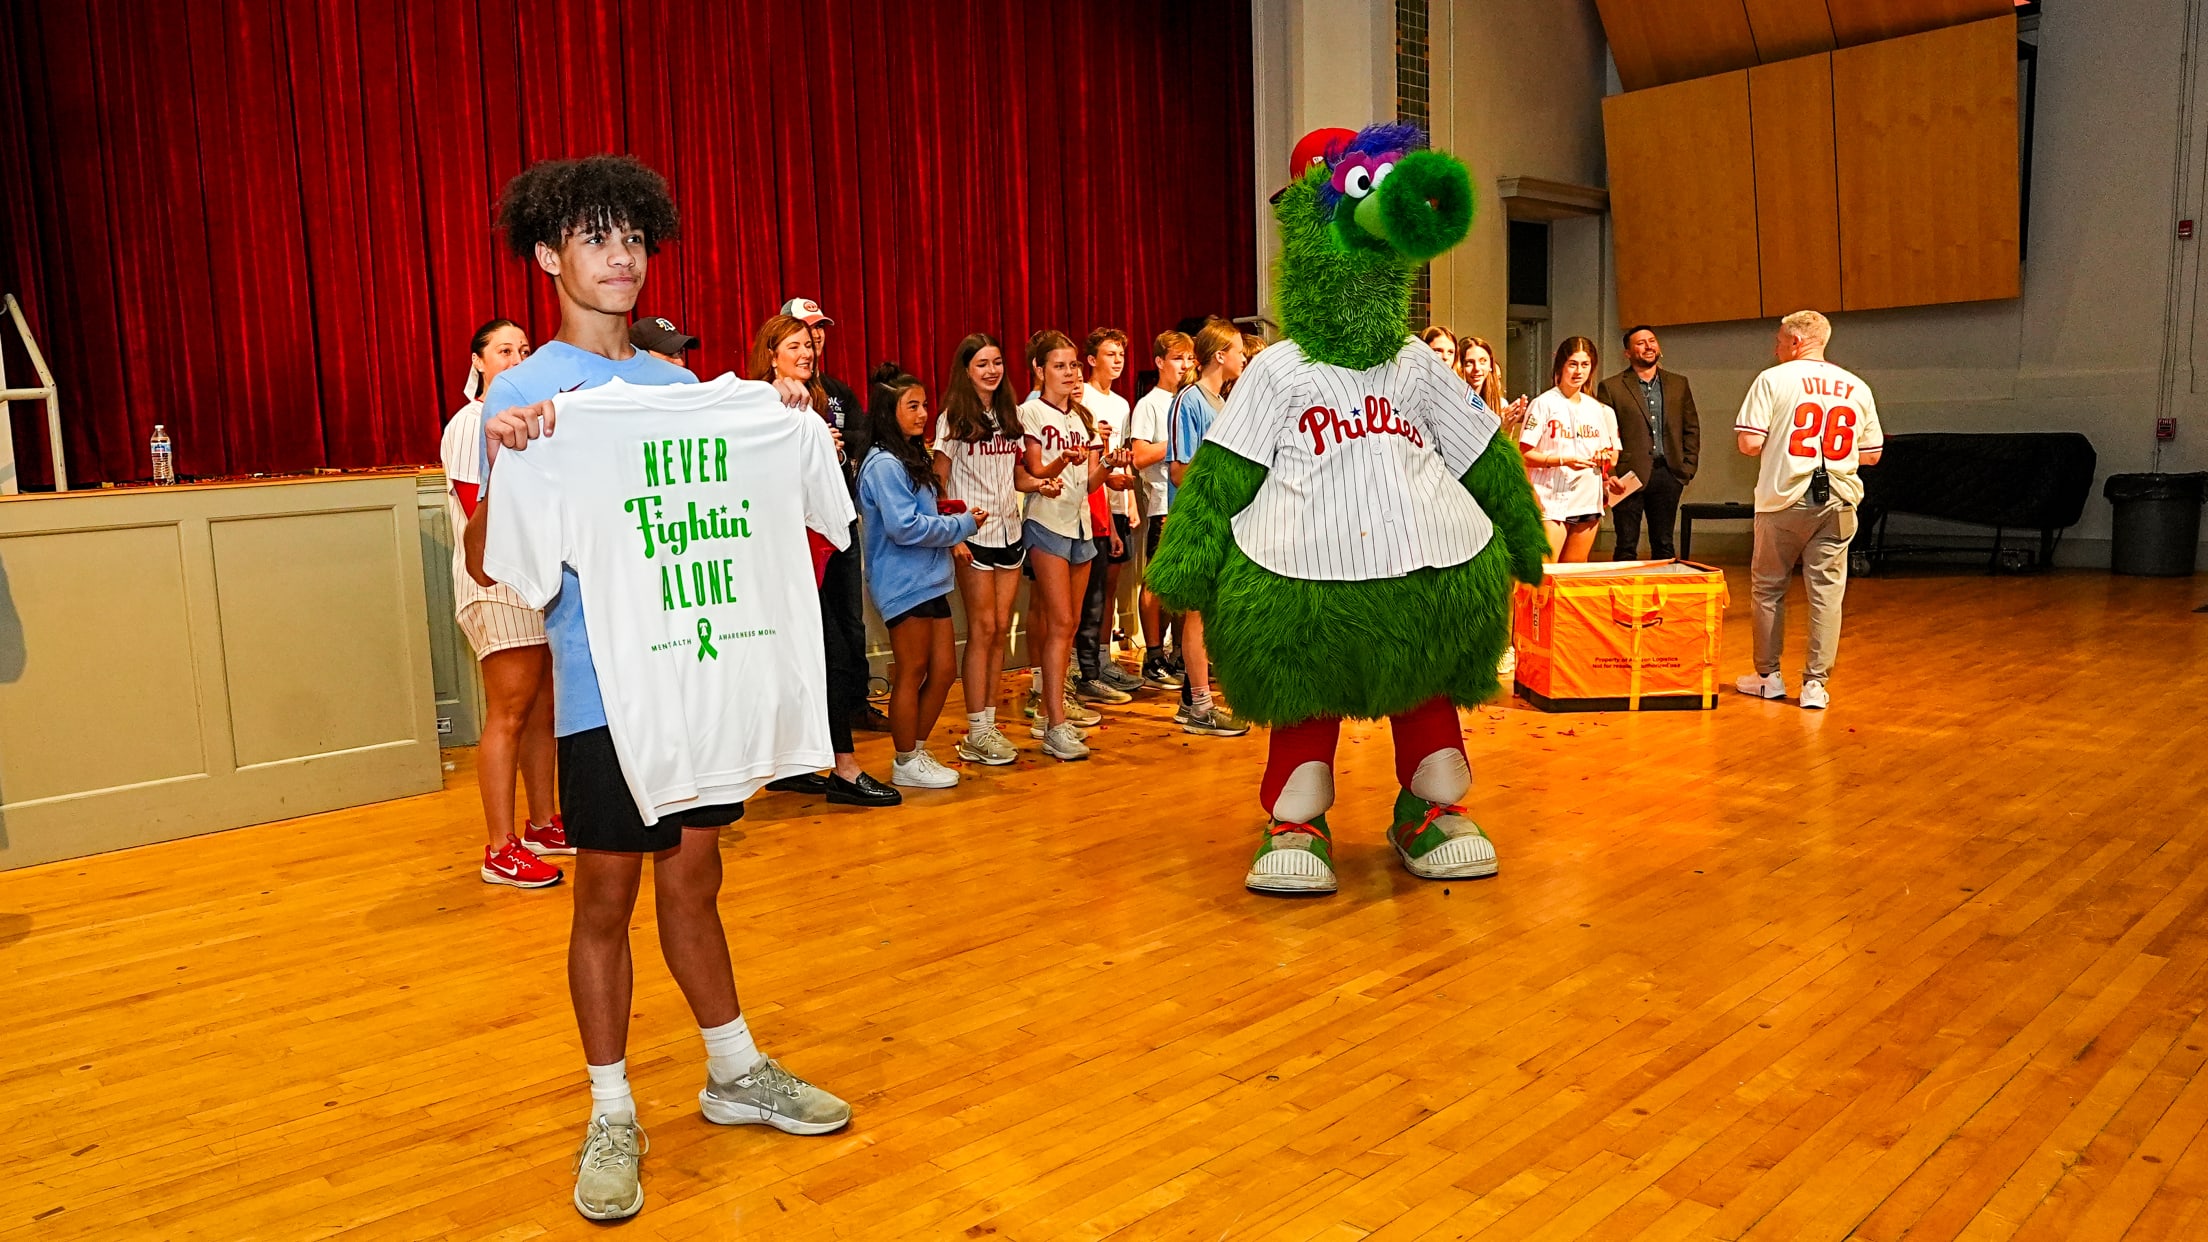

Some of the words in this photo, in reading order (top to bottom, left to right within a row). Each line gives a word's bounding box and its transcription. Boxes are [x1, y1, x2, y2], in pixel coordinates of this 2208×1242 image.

[1802, 377, 1855, 399] UTLEY
[1041, 425, 1091, 451] Phillie
[1299, 395, 1424, 456] Phillies
[1788, 402, 1857, 461] 26
[643, 438, 728, 487] NEVER
[624, 495, 752, 559] Fightin'
[662, 559, 737, 612] ALONE
